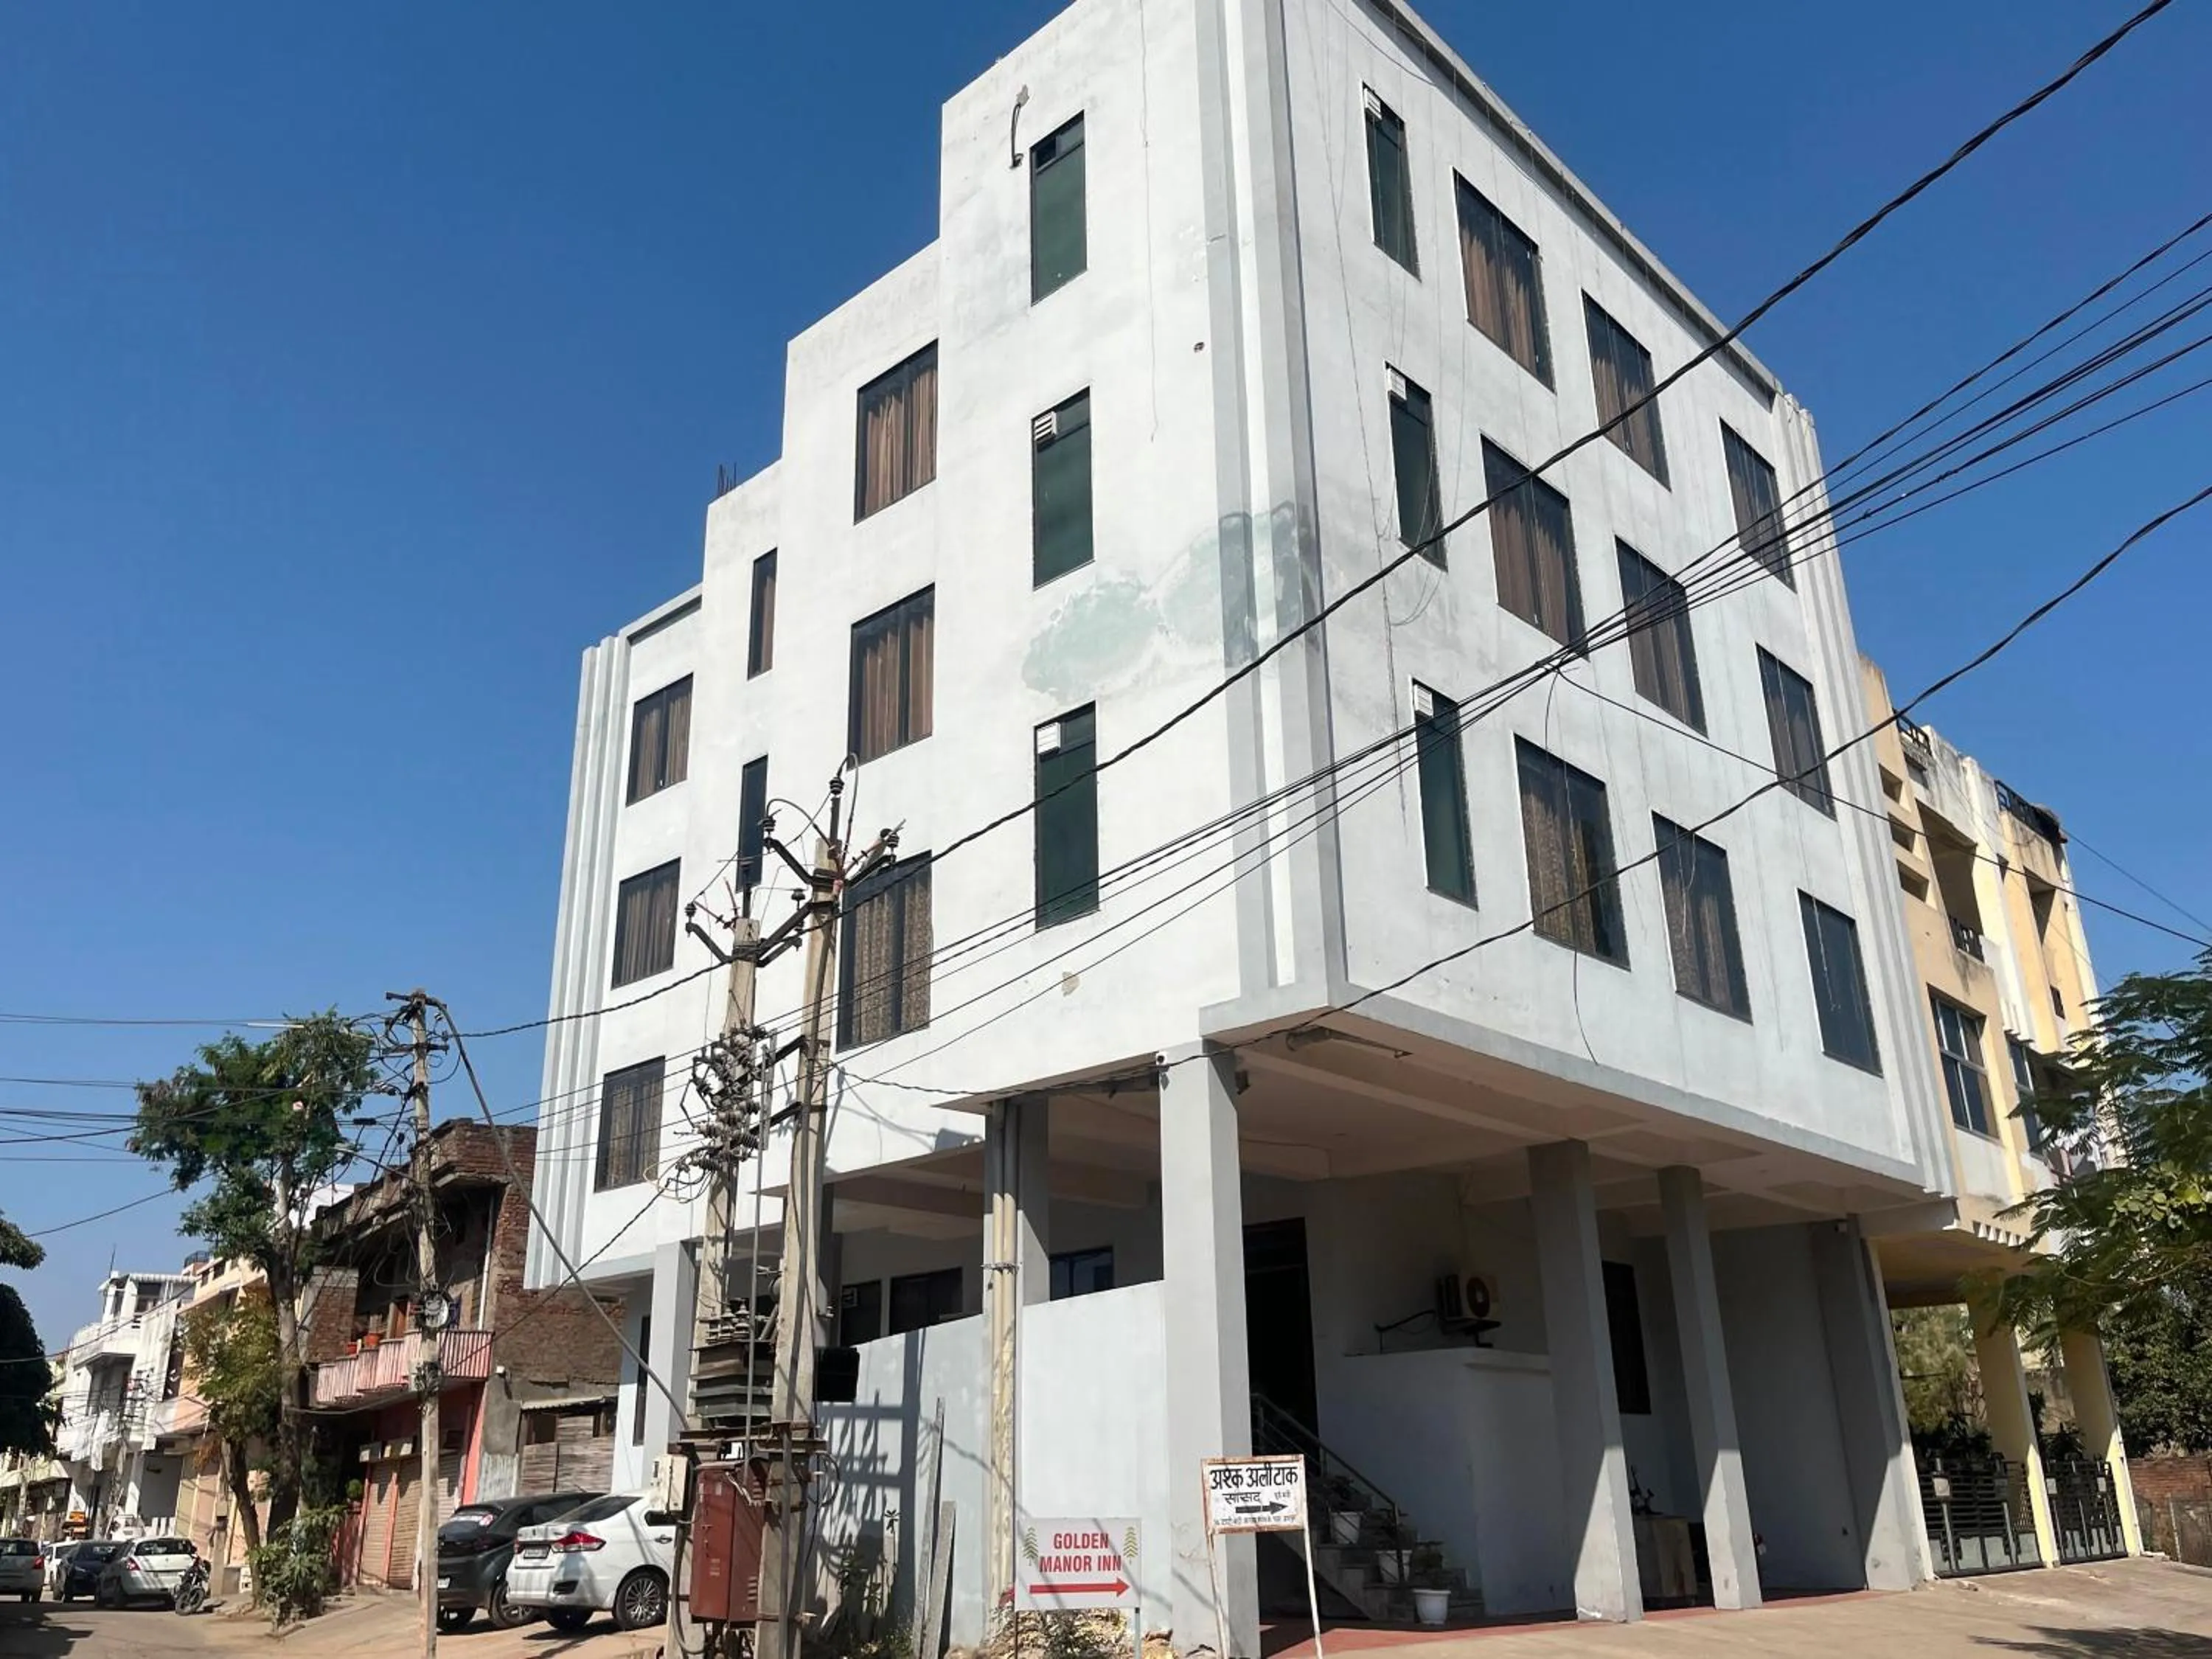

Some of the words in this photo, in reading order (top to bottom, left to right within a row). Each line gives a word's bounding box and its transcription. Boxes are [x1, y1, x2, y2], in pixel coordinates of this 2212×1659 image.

[1210, 1467, 1244, 1489] अश्क
[1053, 1533, 1108, 1550] GOLDEN
[1039, 1556, 1091, 1573] MANOR
[1097, 1555, 1121, 1571] INN
